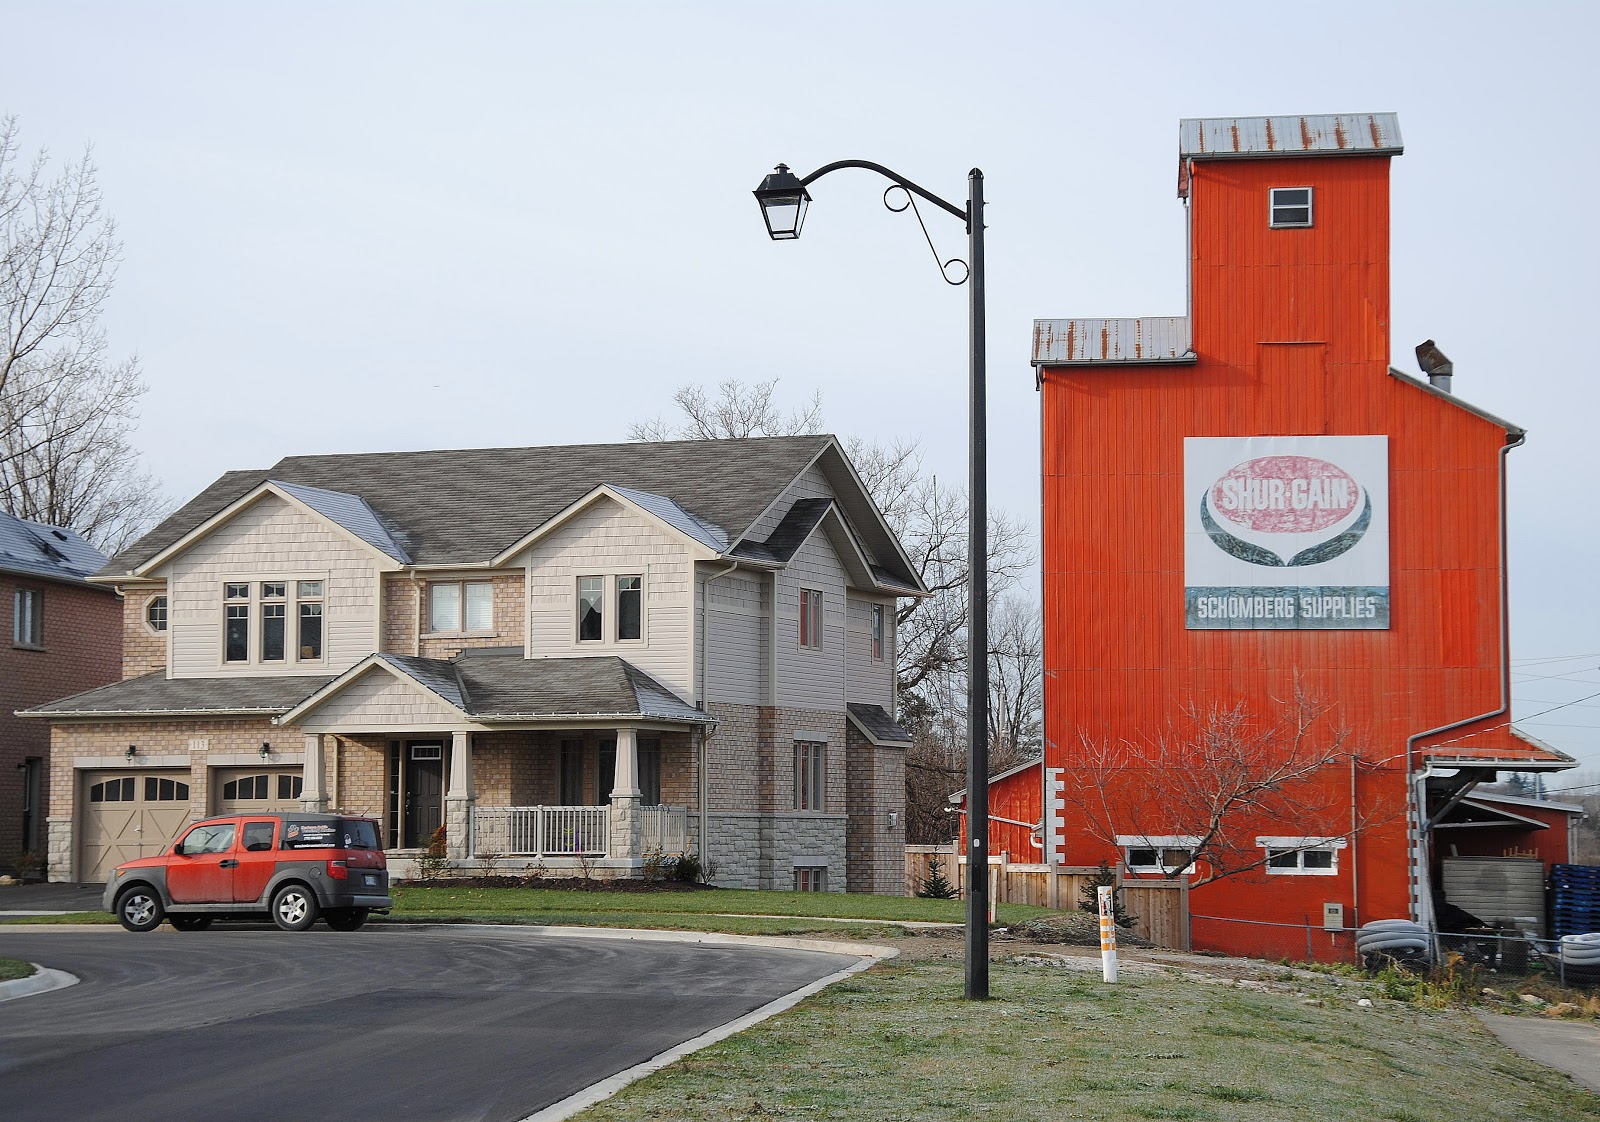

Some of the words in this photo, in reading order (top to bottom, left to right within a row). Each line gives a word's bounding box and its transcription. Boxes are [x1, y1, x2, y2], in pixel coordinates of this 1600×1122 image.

[1198, 597, 1295, 619] SCHOMBERG
[1301, 597, 1376, 619] SUPPLIES
[193, 740, 205, 750] 113
